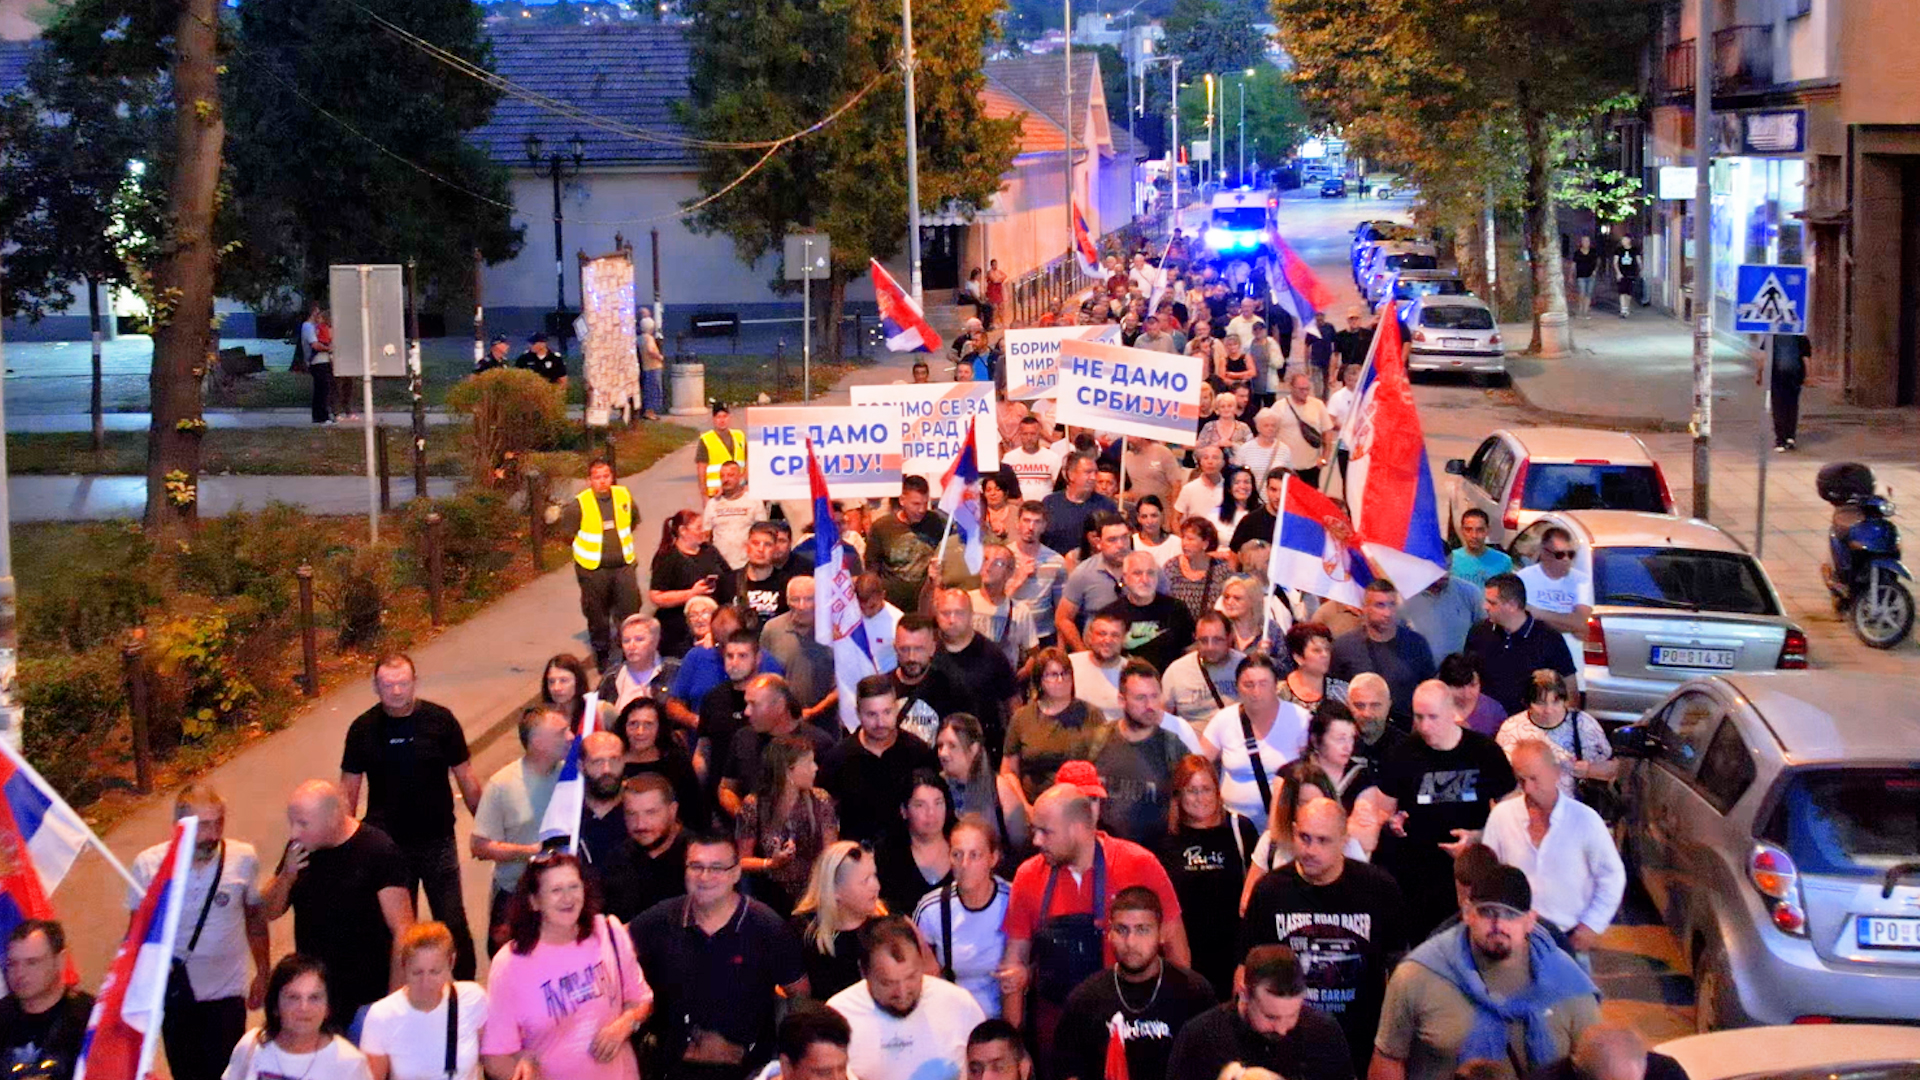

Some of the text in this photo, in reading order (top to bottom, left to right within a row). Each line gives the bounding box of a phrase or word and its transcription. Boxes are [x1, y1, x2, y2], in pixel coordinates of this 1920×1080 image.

[1011, 341, 1061, 355] БОРИМ
[1073, 357, 1188, 392] НЕ ДАМО
[939, 400, 961, 416] СЕ
[966, 398, 990, 415] ЗА
[1077, 386, 1179, 420] СРБИЈУ!
[763, 423, 889, 448] НЕ ДАМО
[921, 420, 959, 439] РАД
[902, 441, 962, 460] ПРЕДА
[1275, 912, 1312, 941] CLASSIC
[1341, 913, 1371, 943] RACER
[1874, 921, 1898, 941] PO
